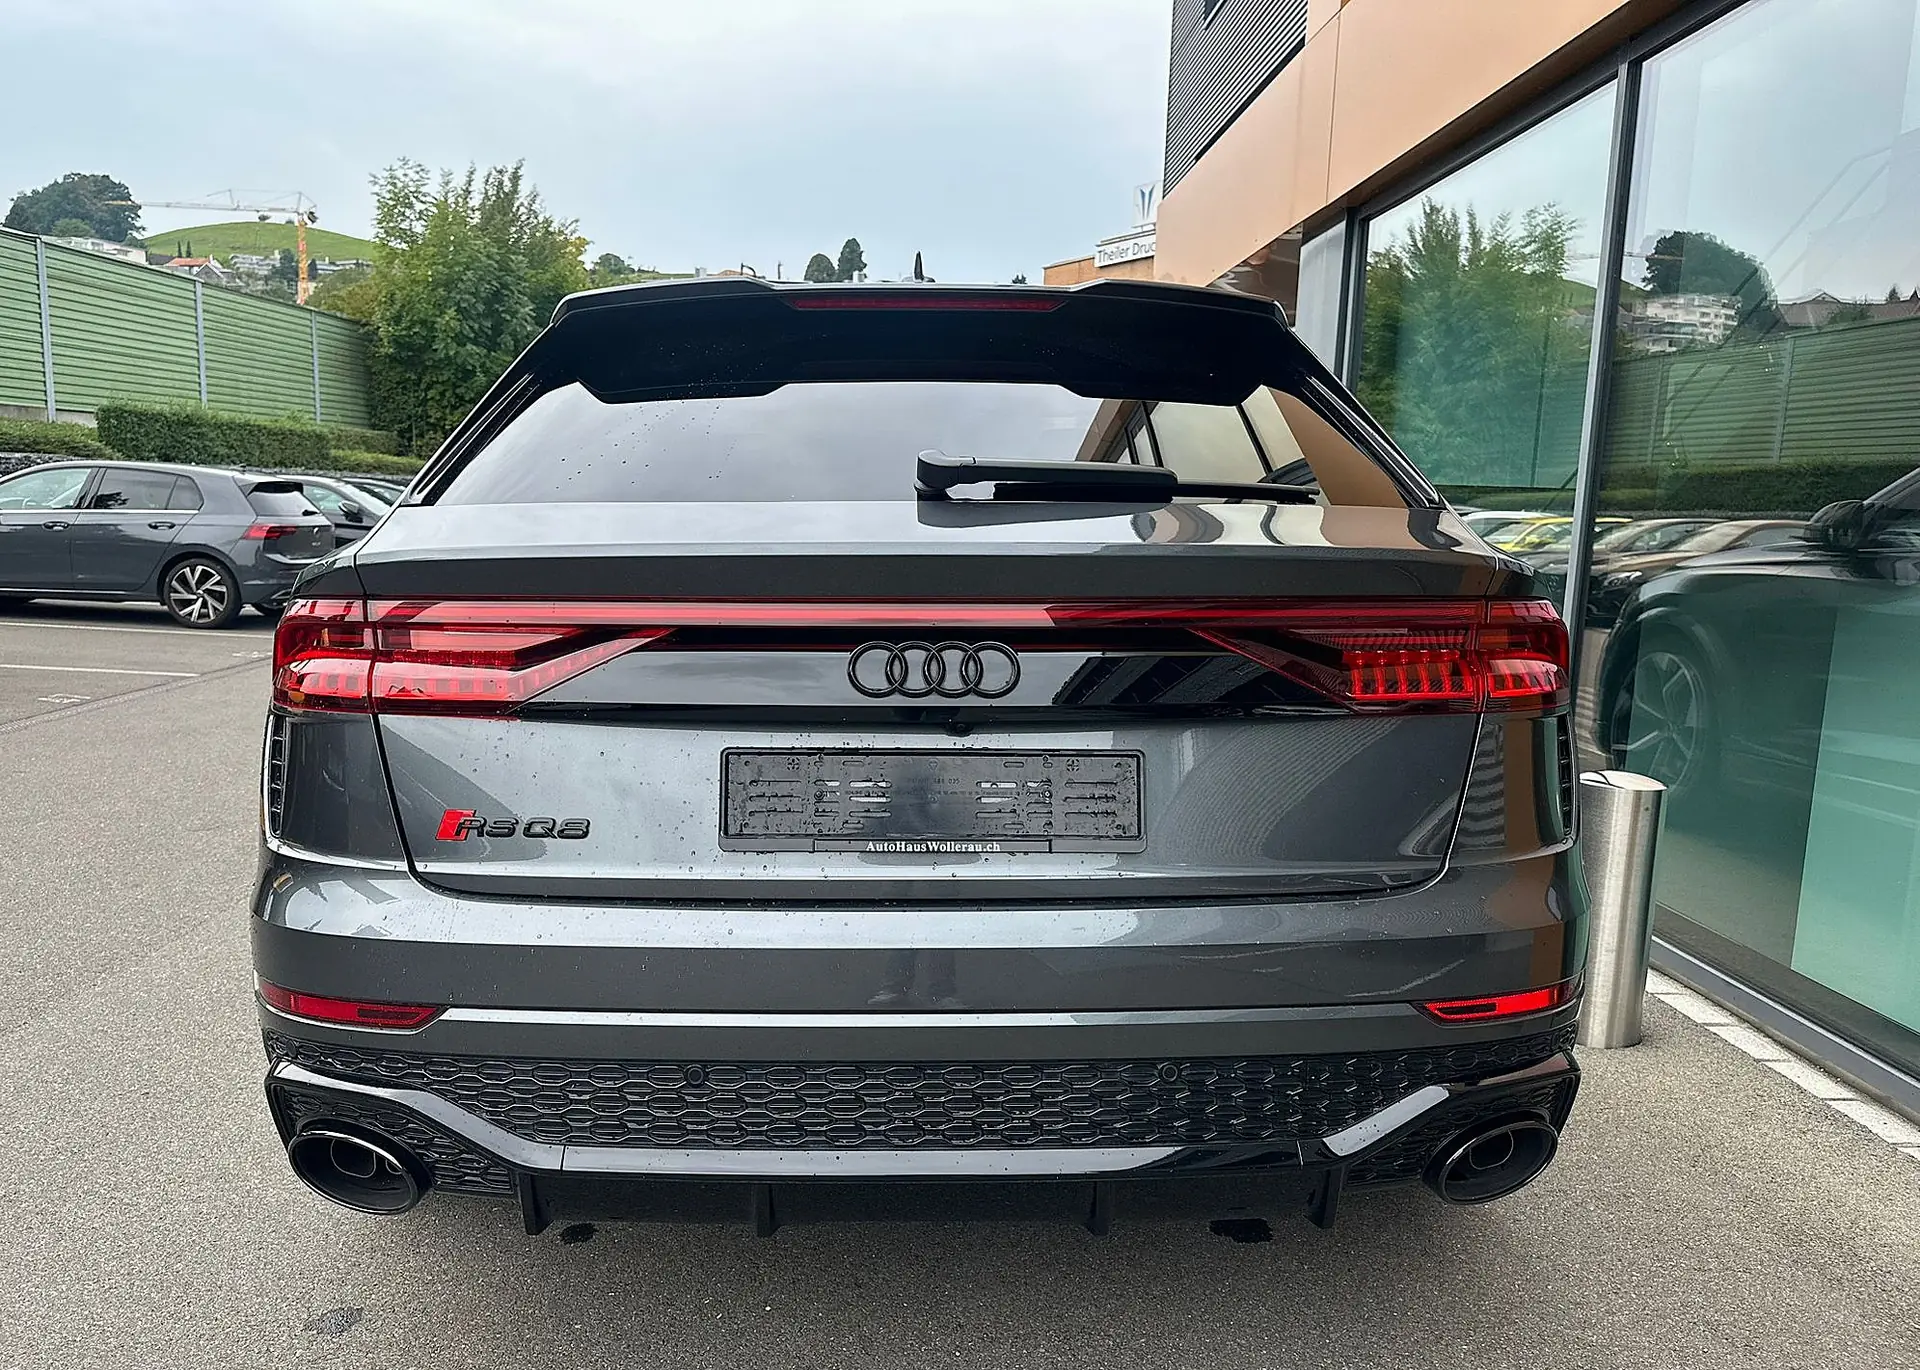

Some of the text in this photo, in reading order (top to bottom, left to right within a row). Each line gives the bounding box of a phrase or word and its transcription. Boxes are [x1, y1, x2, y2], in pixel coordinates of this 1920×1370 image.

[1097, 246, 1130, 262] Theiler
[443, 810, 590, 840] RS Q8
[866, 841, 1001, 852] AutoHausWollerau.ch
